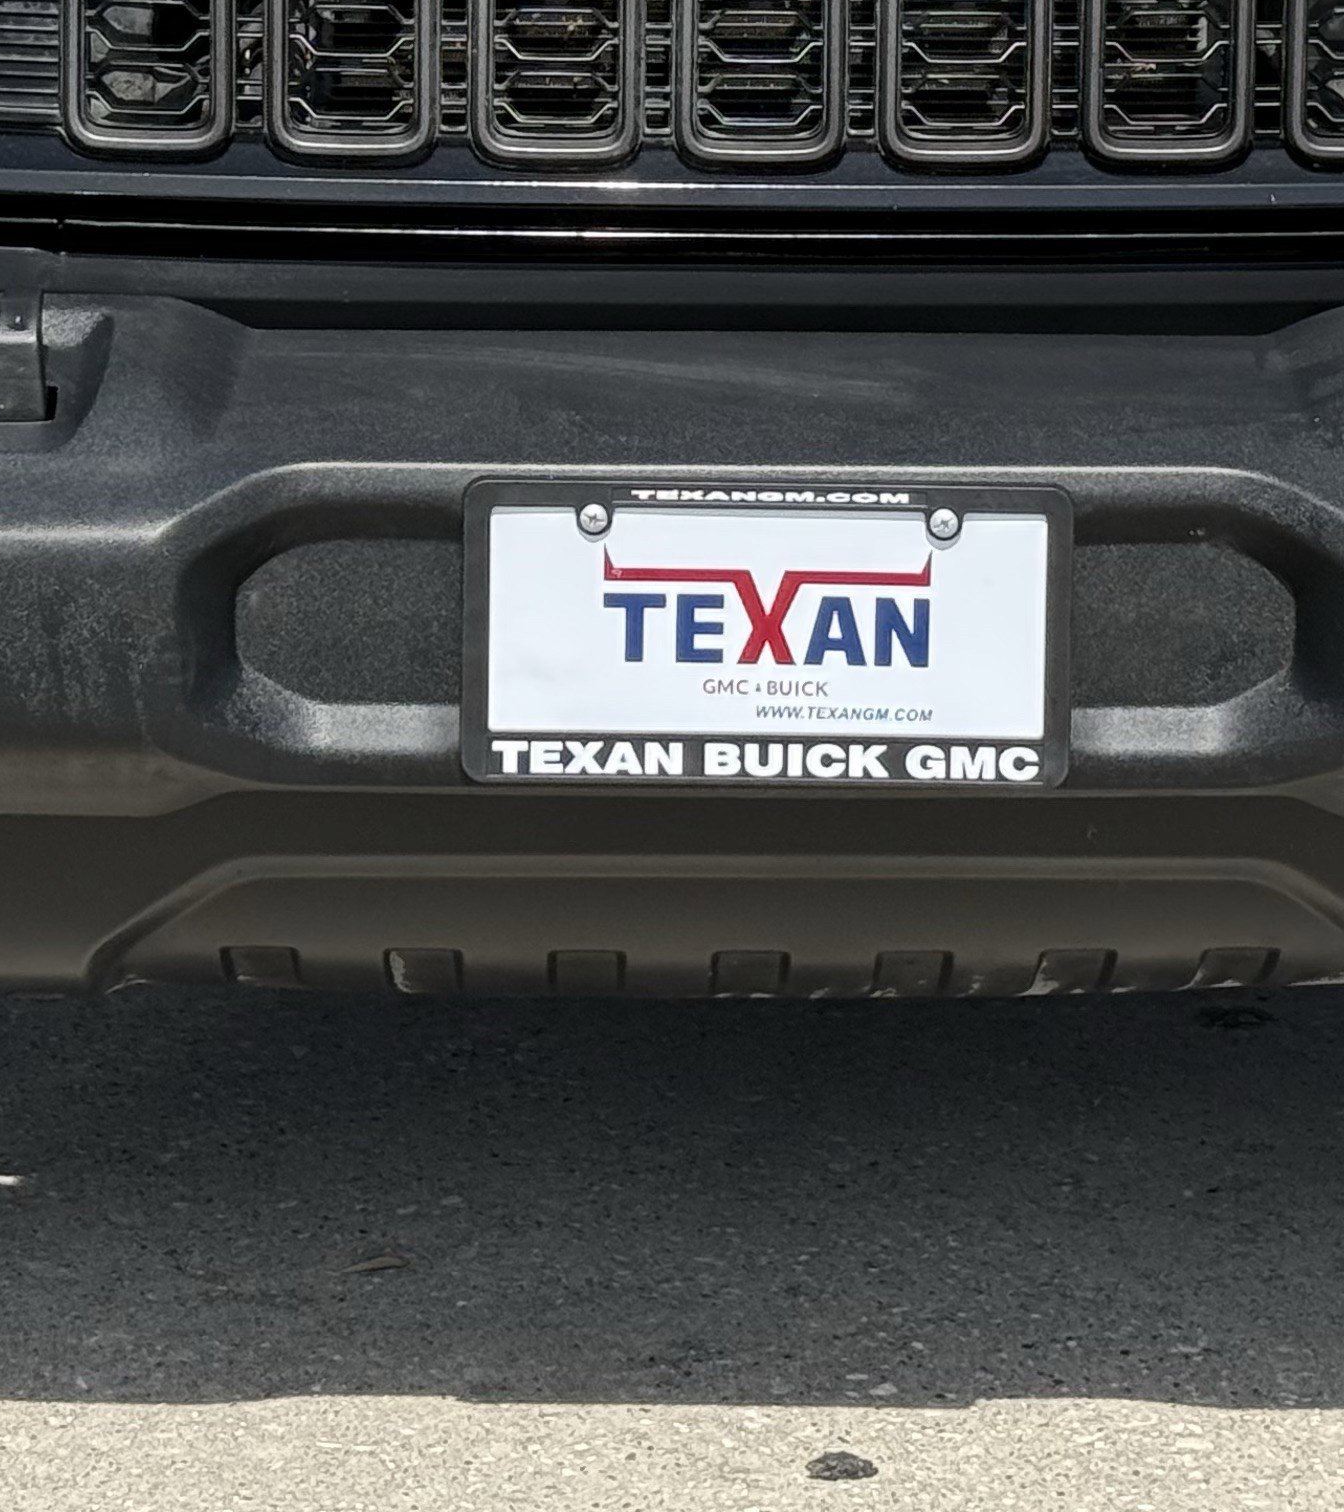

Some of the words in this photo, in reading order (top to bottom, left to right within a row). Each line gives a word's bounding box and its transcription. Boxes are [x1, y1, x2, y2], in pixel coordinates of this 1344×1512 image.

[630, 489, 910, 505] TEXANGM.COM
[604, 570, 931, 668] TEXAN
[702, 678, 750, 696] GMC
[766, 680, 829, 697] BUICK
[755, 705, 934, 722] WWW.TEXANGM.COM
[491, 740, 684, 775] TEXAN
[703, 742, 890, 778] BUICK
[905, 744, 1040, 782] GMC
